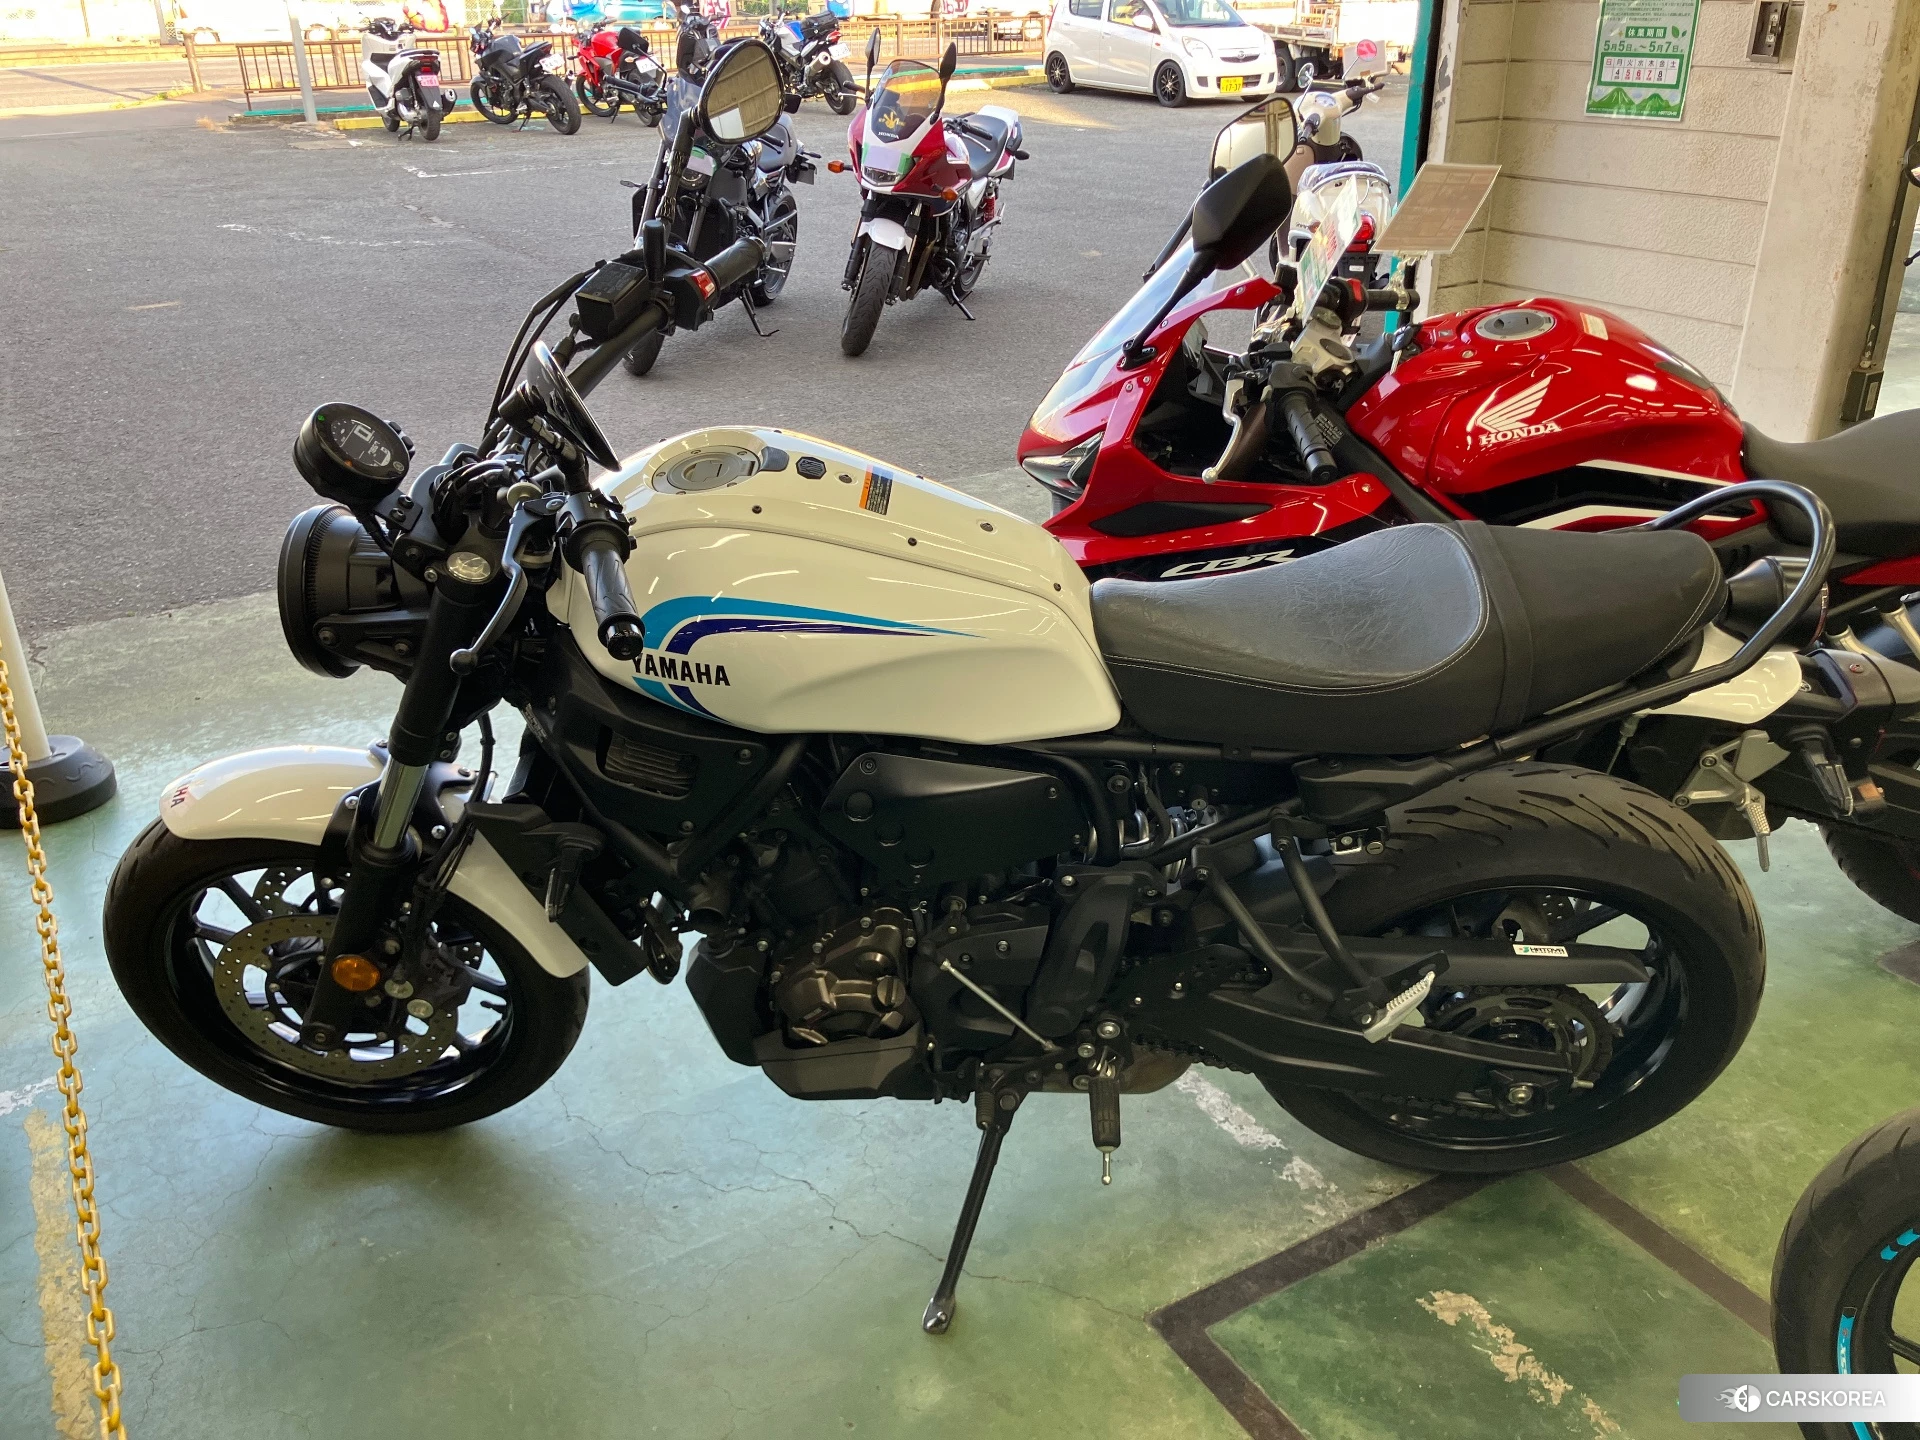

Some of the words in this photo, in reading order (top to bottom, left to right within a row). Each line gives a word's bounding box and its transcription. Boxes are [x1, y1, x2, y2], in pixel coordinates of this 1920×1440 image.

[1627, 59, 1634, 67] 火
[877, 131, 900, 140] HONDA
[1480, 421, 1562, 446] HONDA
[1160, 549, 1300, 578] CBR
[632, 652, 731, 687] YAMAHA
